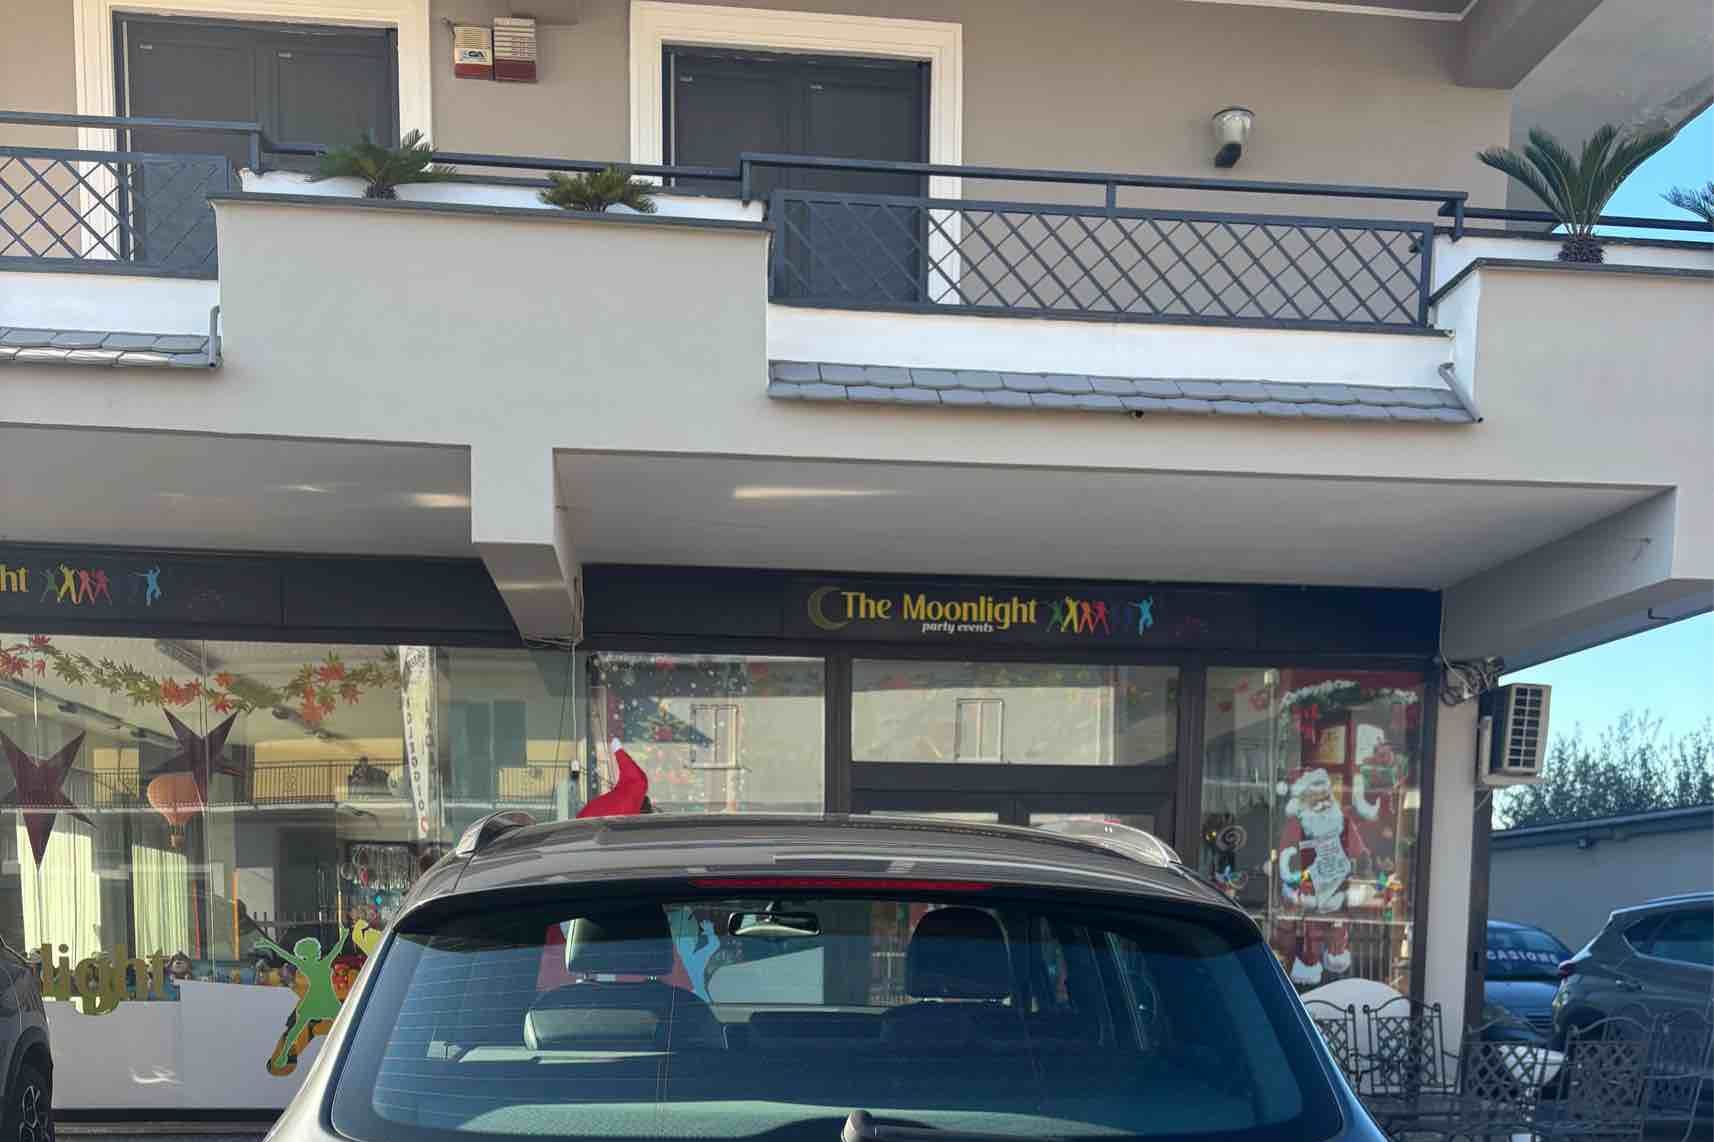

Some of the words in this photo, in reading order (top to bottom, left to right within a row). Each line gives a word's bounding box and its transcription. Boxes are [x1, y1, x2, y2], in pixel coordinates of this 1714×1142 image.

[841, 591, 892, 620] The
[903, 593, 1037, 630] Moonlight
[921, 620, 955, 634] party
[958, 622, 995, 634] events
